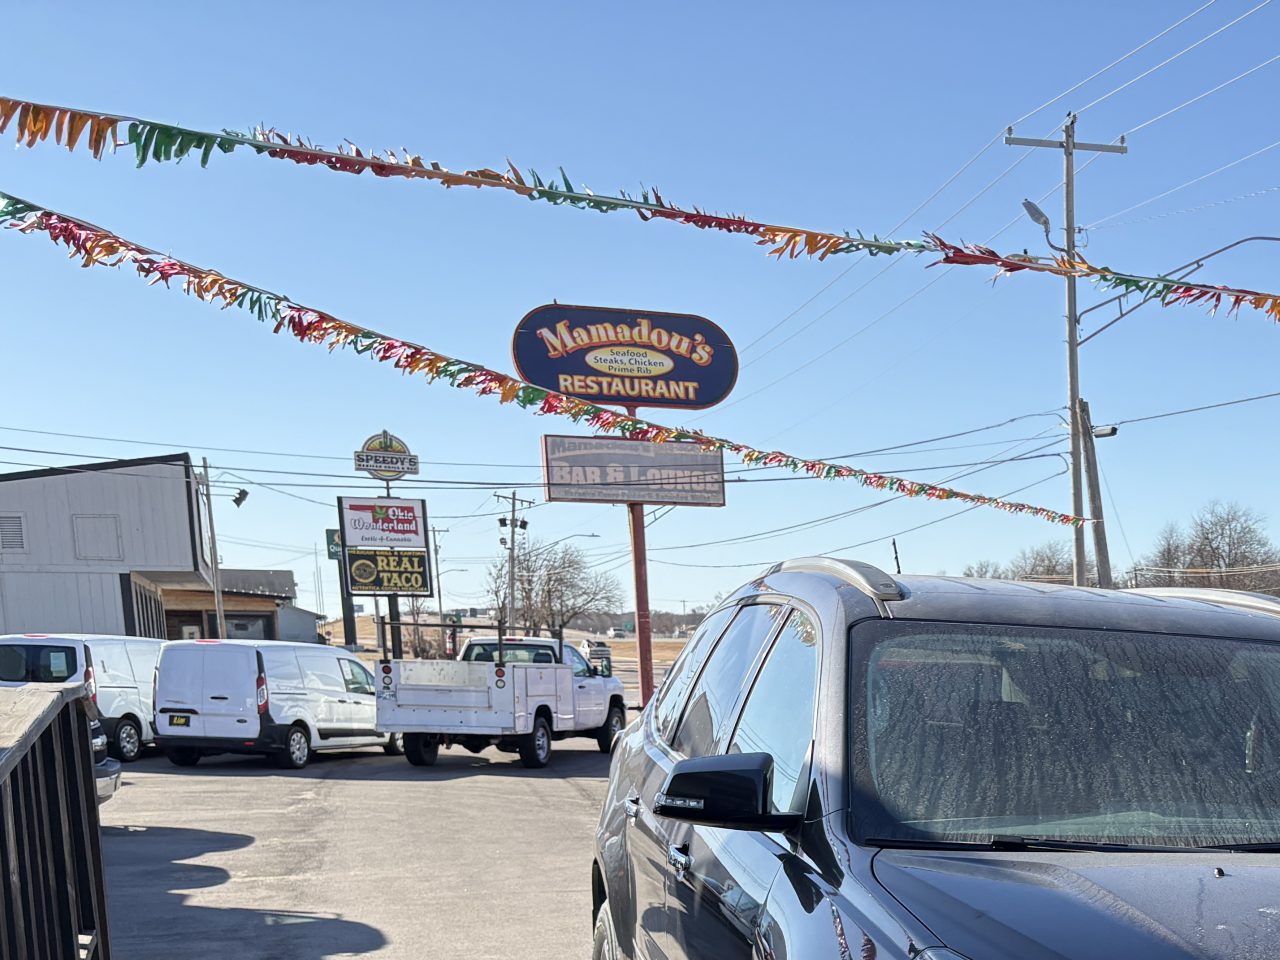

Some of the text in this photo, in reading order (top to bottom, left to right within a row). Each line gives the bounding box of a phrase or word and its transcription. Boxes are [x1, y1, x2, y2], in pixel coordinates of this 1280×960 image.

[536, 318, 714, 367] Mamadou's
[609, 348, 648, 358] Seafood
[593, 356, 665, 368] Steaks, Chicken
[608, 365, 652, 375] Prime Rib
[558, 374, 699, 400] RESTAURANT
[356, 454, 417, 466] SPEEDY'S
[551, 460, 721, 491] BAR & LOUNGE
[388, 506, 414, 520] Okie
[350, 517, 417, 531] Wonderland
[376, 556, 424, 572] REAL
[380, 572, 423, 588] TACO
